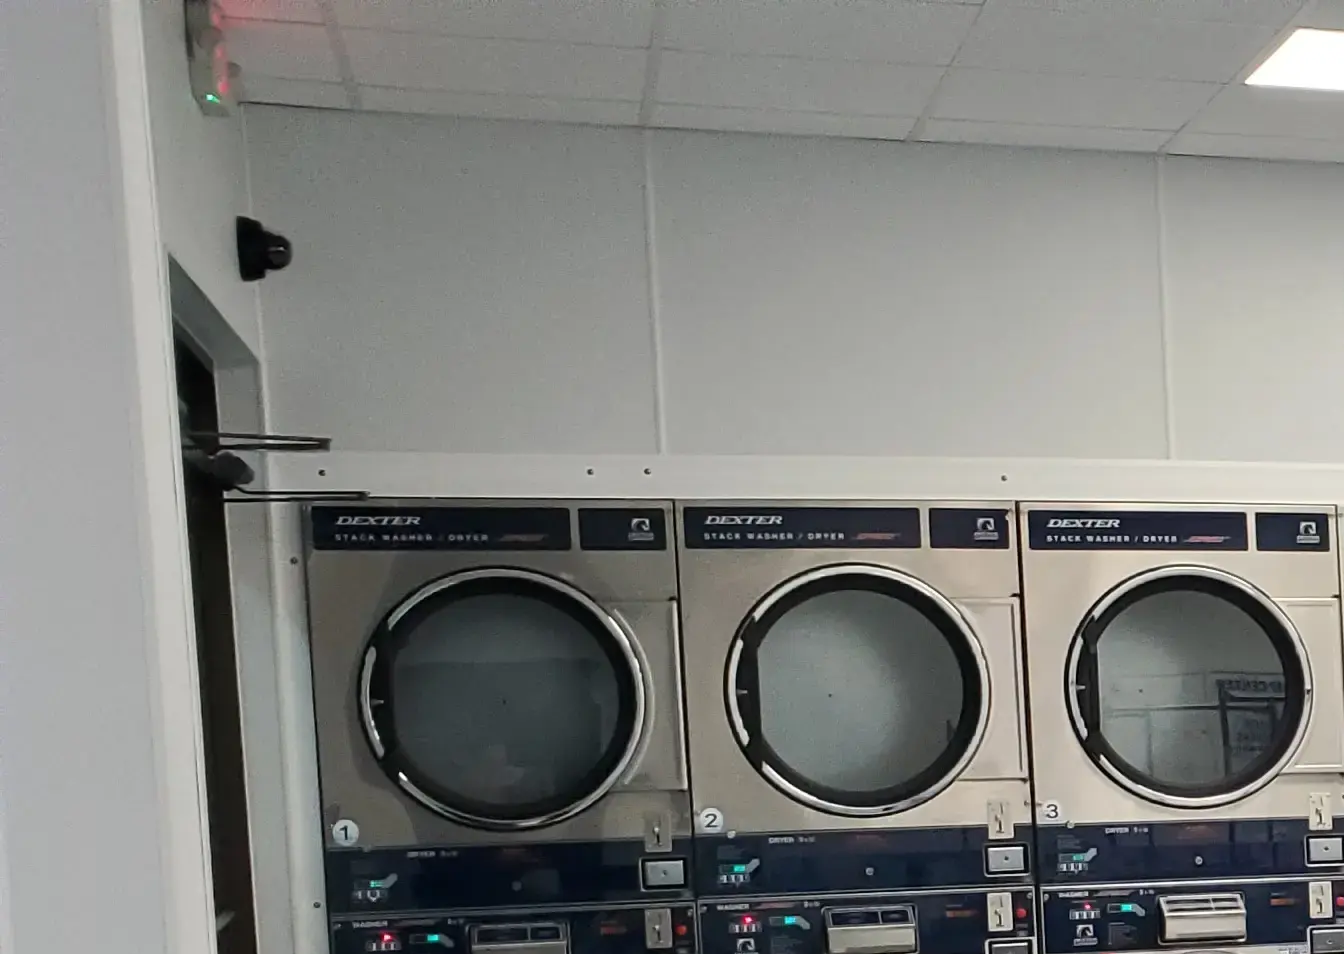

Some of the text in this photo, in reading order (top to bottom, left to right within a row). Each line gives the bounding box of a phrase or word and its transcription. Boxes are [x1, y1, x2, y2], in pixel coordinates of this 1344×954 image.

[335, 516, 421, 525] DEXTER
[704, 516, 783, 524] DEXTER
[1046, 518, 1120, 528] DEXTER
[1047, 535, 1082, 543] STACK
[1086, 535, 1129, 543] WASHER
[1143, 535, 1177, 543] DRYER
[1046, 804, 1059, 818] 3
[704, 813, 718, 828] 2
[339, 825, 349, 840] 1
